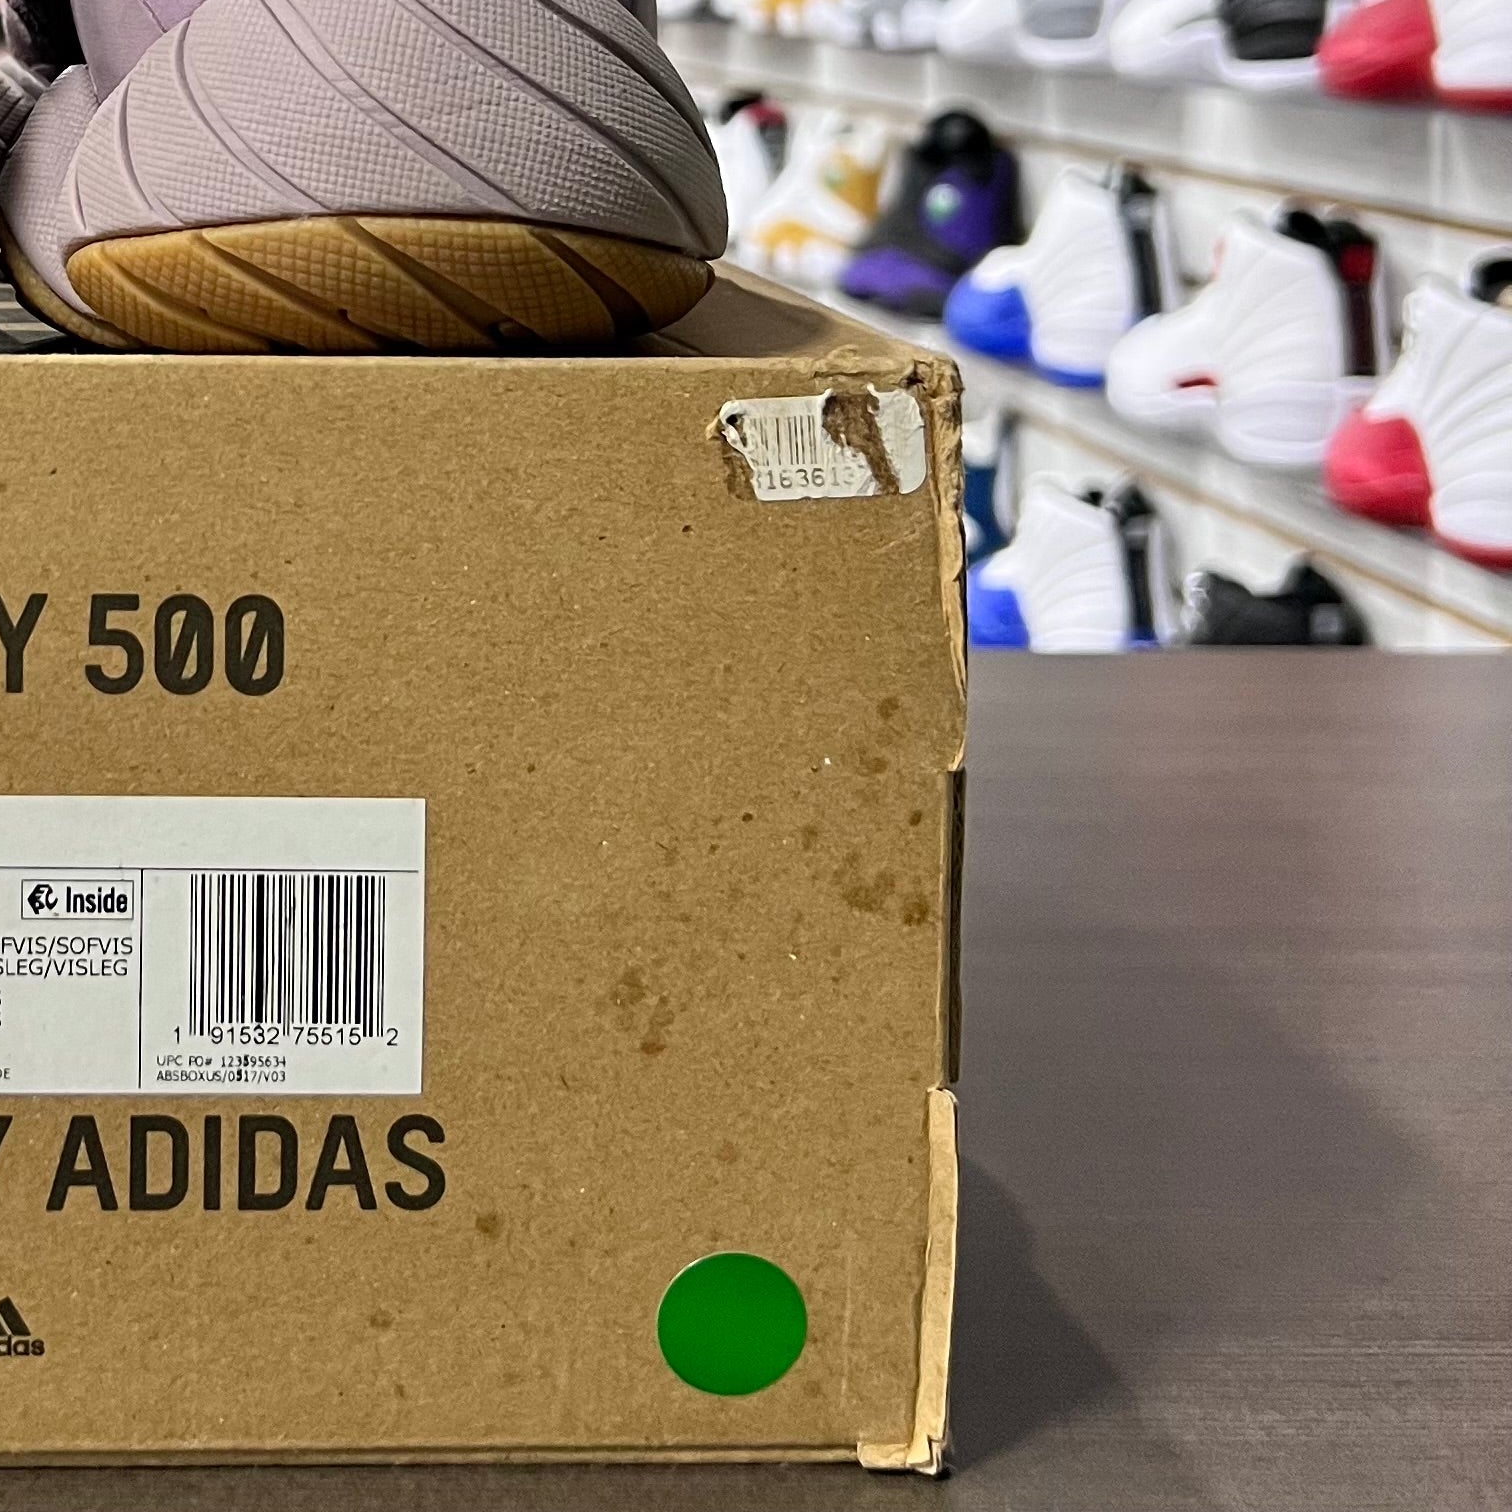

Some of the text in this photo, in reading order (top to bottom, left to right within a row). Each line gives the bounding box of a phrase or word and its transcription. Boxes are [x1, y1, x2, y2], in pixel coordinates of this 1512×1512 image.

[84, 593, 285, 697] 500
[66, 886, 128, 914] Inside
[211, 1026, 280, 1045] 91532
[293, 1026, 361, 1046] 75515
[156, 1054, 183, 1067] UPC
[188, 1055, 213, 1067] PO#
[45, 1113, 446, 1212] ADIDAS
